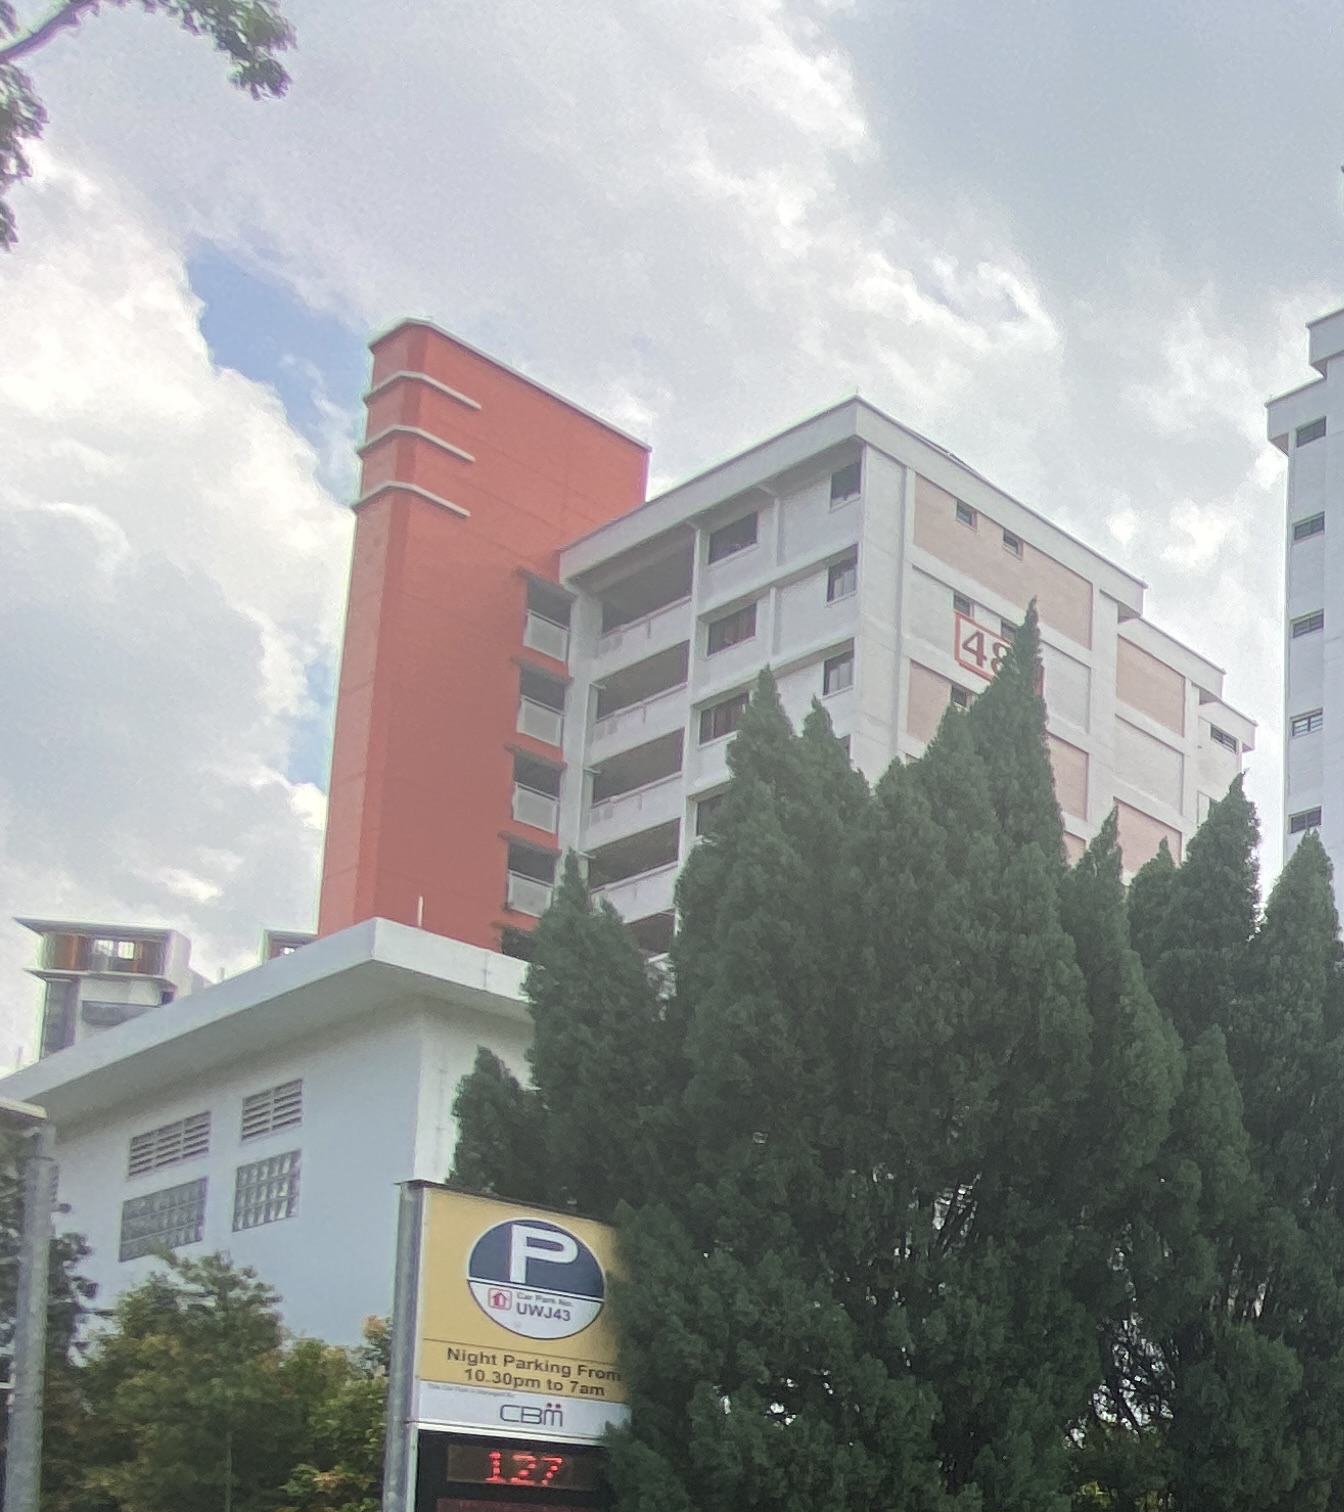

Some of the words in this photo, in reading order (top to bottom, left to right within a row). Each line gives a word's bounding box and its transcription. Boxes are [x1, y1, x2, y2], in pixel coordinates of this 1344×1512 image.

[510, 1224, 578, 1283] P
[516, 1302, 571, 1321] UWJ43
[447, 1347, 497, 1366] Night
[503, 1354, 572, 1378] Parking
[577, 1364, 621, 1381] From
[464, 1368, 541, 1389] 10.30pm
[547, 1379, 564, 1392] to
[569, 1381, 605, 1396] 7am
[485, 1451, 564, 1486] 127
